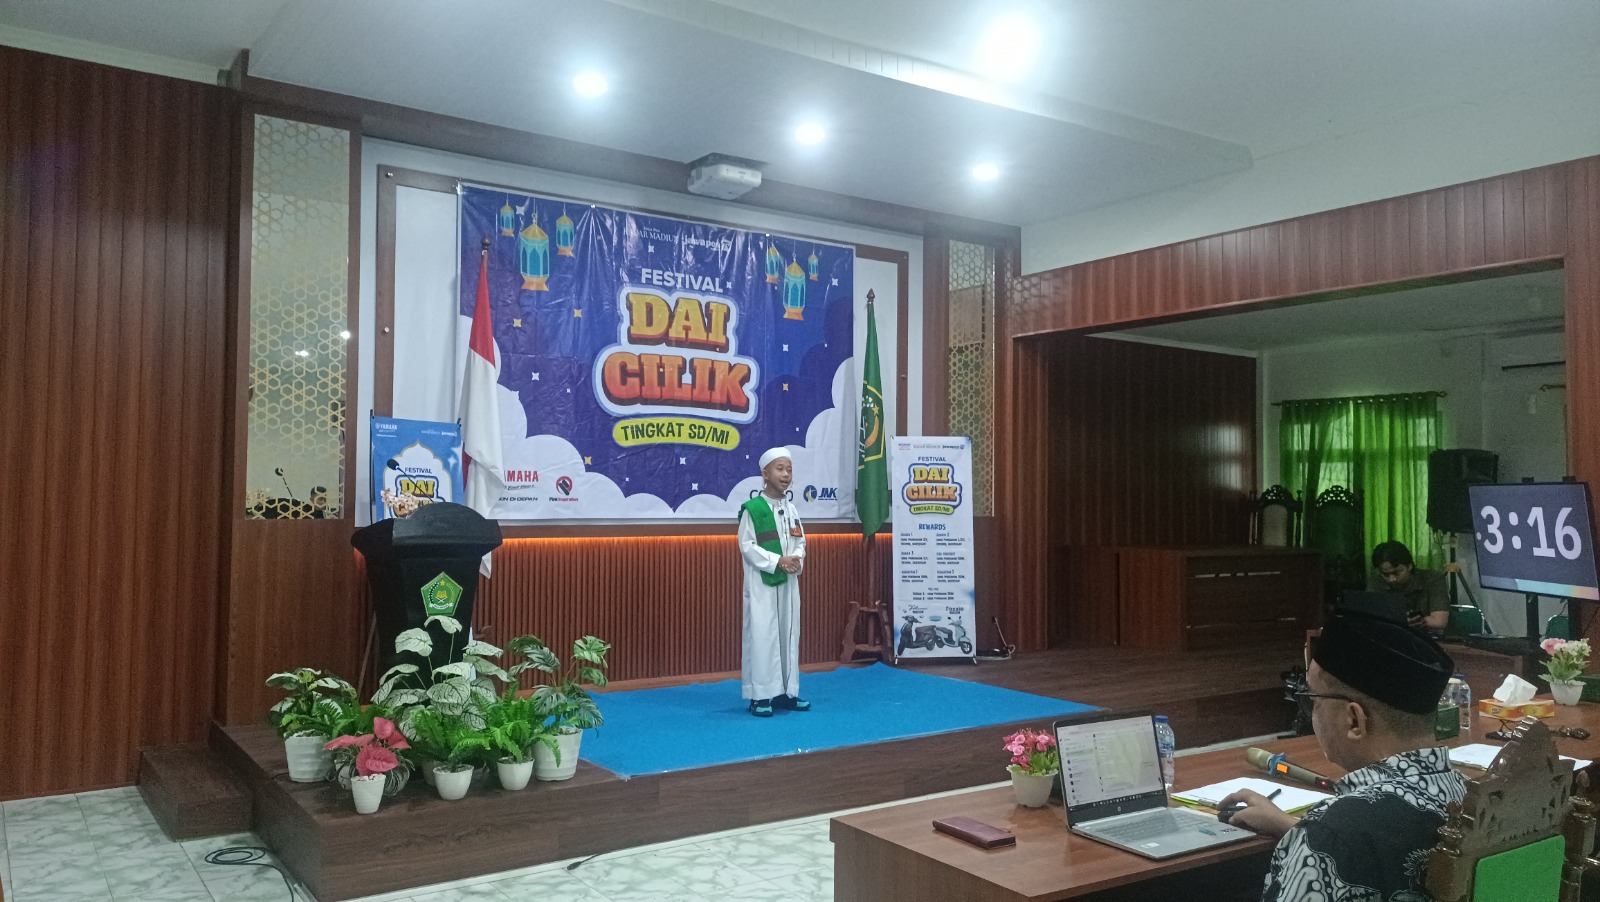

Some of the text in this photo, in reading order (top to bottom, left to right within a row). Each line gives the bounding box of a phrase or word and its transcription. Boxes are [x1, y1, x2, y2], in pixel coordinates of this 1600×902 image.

[642, 268, 723, 292] FESTIVAL
[626, 293, 730, 352] DAI
[602, 352, 751, 413] CILIK
[621, 422, 730, 444] TINGKAT SD/MI
[504, 470, 538, 482] MAHA
[913, 467, 949, 483] DAI
[399, 480, 435, 498] DAI
[906, 486, 957, 502] CILIK
